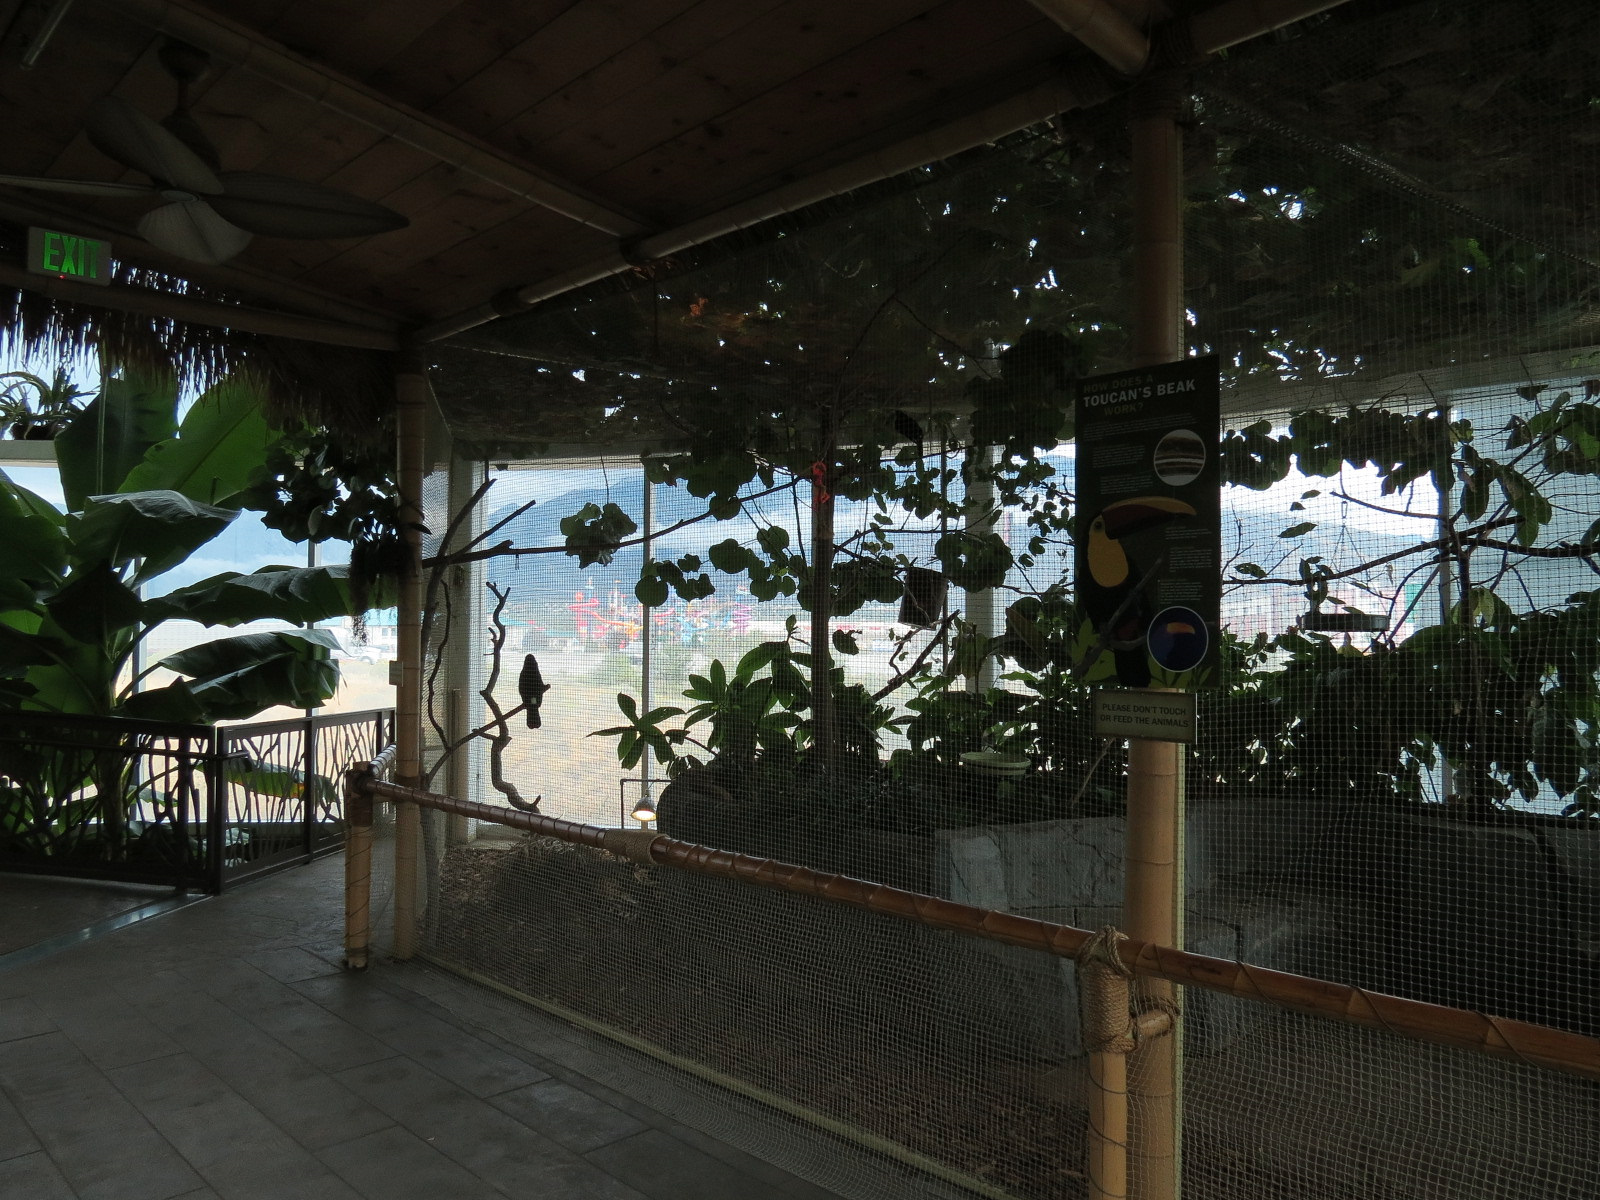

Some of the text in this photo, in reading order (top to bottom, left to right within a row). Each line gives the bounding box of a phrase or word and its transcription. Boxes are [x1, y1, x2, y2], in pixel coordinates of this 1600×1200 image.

[43, 231, 102, 279] EXIT
[1083, 374, 1154, 393] HOW DOES A
[1083, 378, 1196, 408] TOUCAN'S BEAK
[1104, 402, 1144, 416] WORK?
[1102, 703, 1186, 715] PLEASE DON'T TOUCH
[1100, 714, 1189, 728] OR FEED THE ANIMALS
